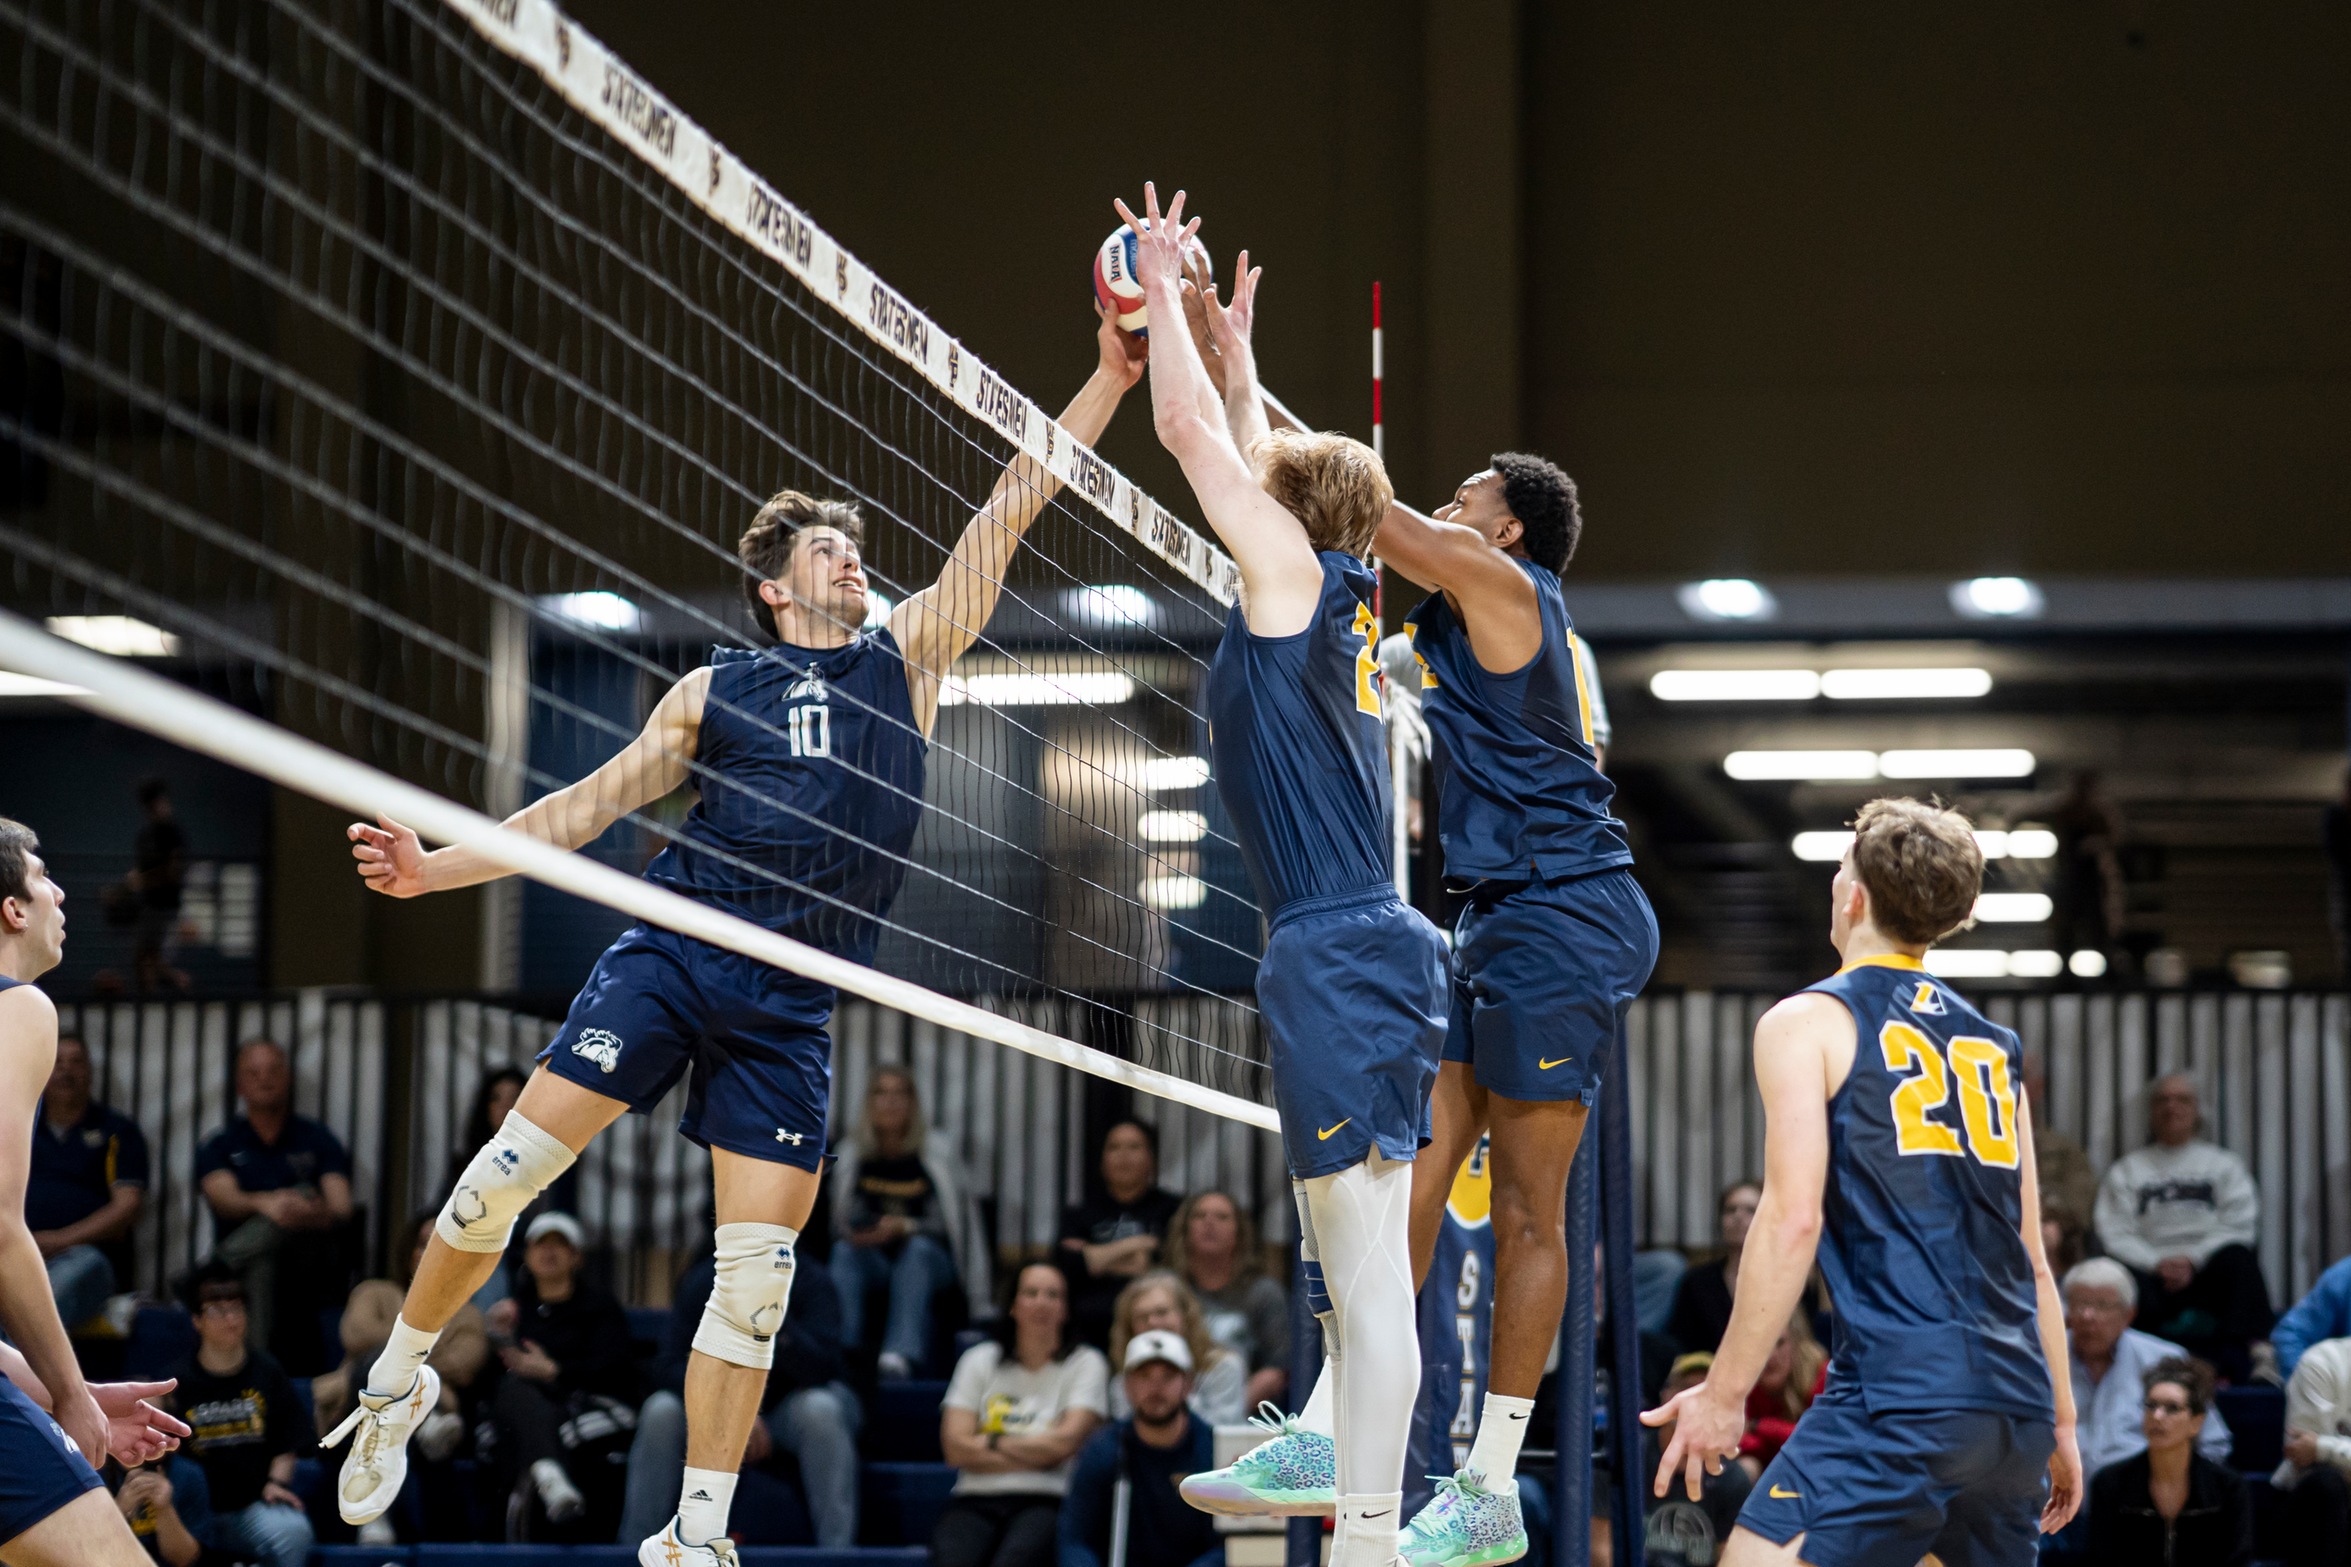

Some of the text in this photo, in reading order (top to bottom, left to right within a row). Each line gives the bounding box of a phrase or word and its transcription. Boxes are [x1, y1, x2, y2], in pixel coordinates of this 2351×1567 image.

[1109, 243, 1122, 283] NAIA
[788, 704, 831, 757] 10
[1878, 1020, 2020, 1170] 20
